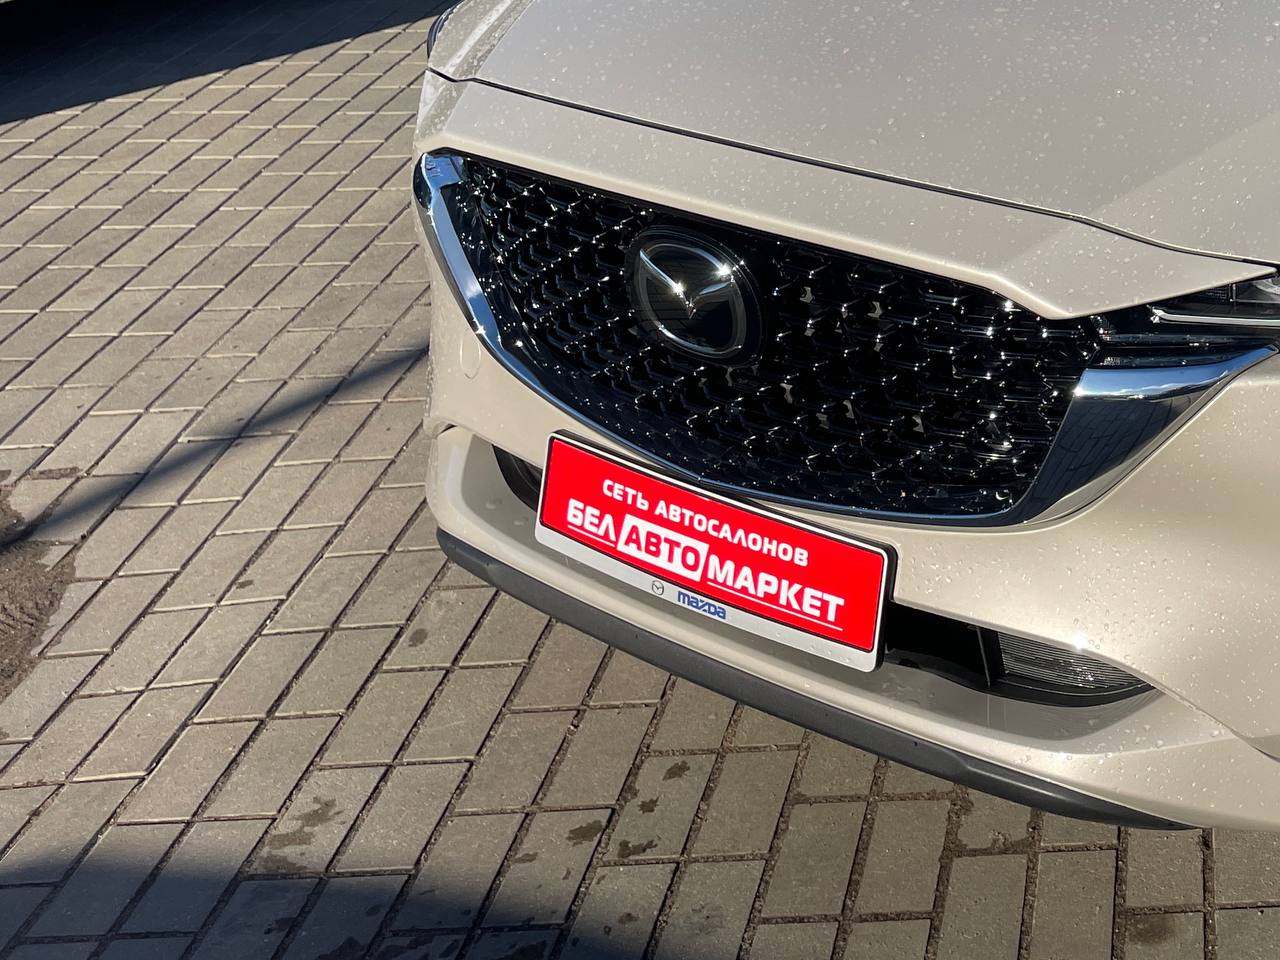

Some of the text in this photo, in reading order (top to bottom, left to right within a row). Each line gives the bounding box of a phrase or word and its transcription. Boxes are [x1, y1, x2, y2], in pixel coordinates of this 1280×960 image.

[566, 497, 845, 623] БЕЛ АВТО МАРКЕТ
[602, 478, 809, 568] СЕТЬ АВТОСАЛОНОВ
